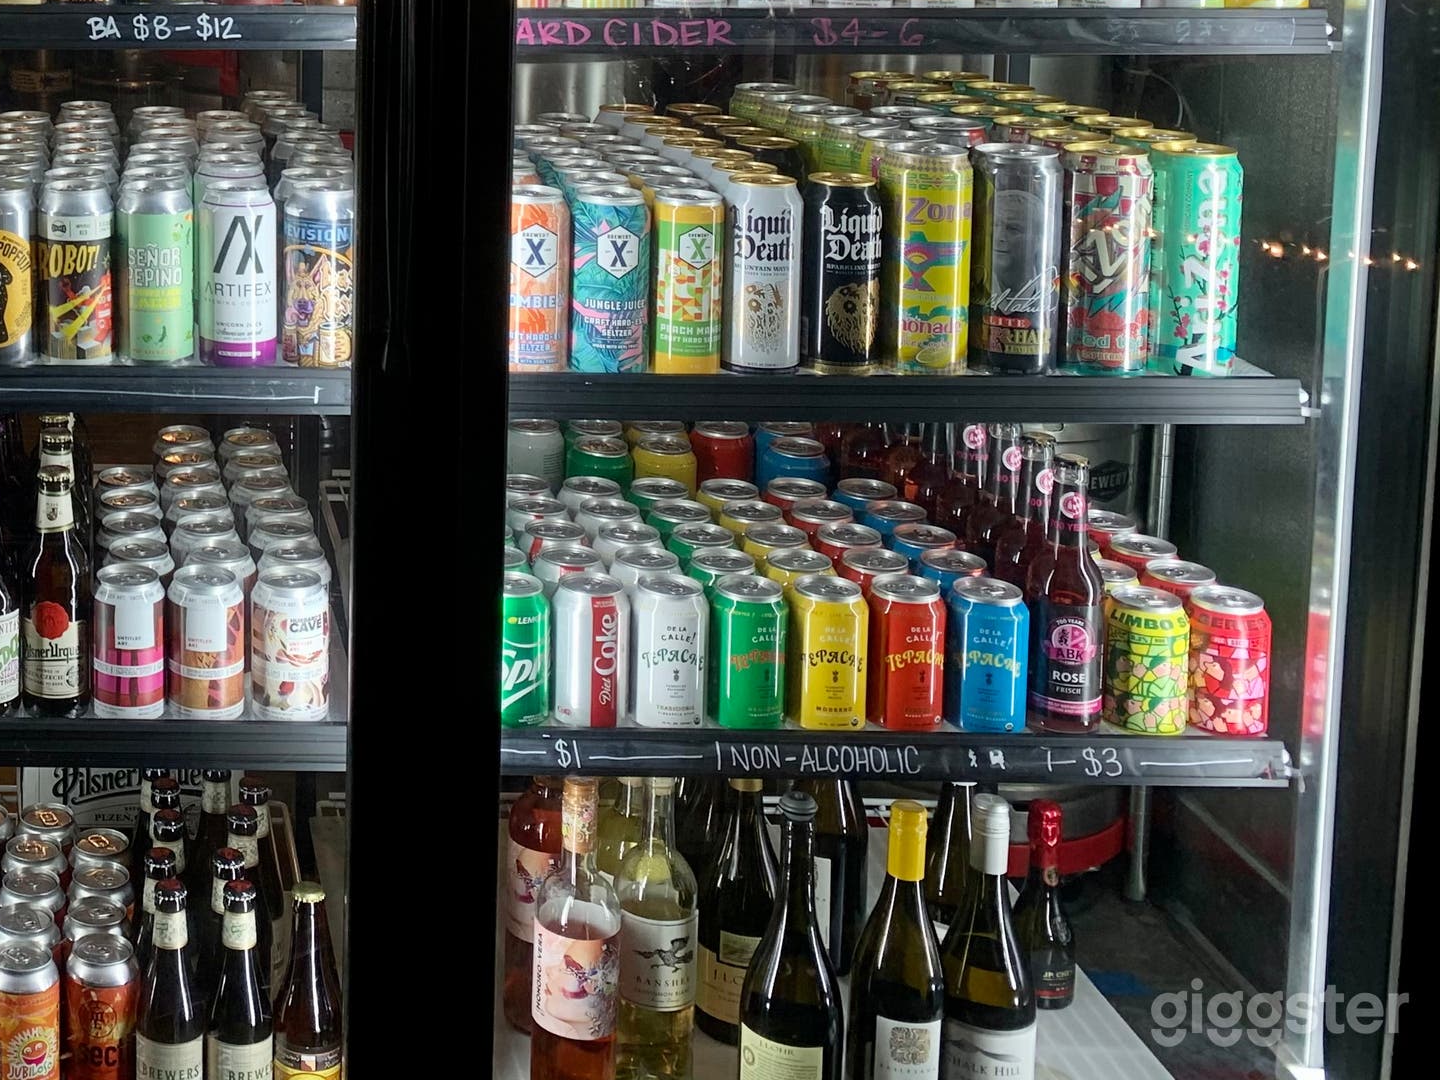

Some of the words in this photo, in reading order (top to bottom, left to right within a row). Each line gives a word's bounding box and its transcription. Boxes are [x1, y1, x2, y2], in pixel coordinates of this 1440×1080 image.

[87, 17, 121, 42] BA
[132, 14, 242, 42] $8-$12
[516, 16, 591, 47] ARD
[603, 17, 735, 47] CIDER
[732, 204, 795, 236] Liquid
[822, 204, 884, 235] Liquid
[128, 243, 181, 266] SEÑOR
[610, 240, 630, 267] X
[733, 234, 796, 262] Death
[824, 234, 883, 261] Death
[40, 243, 101, 280] ROBOT!
[127, 266, 183, 287] PEPINO
[204, 281, 272, 298] ARTIFEX
[584, 298, 621, 311] JUNGLE
[622, 298, 647, 311] JUICE
[289, 619, 323, 632] CAVE
[1110, 608, 1171, 629] LIMBO
[593, 613, 618, 676] Coke
[661, 631, 698, 646] CALLE!
[641, 648, 705, 672] TEPACHE
[1055, 647, 1084, 660] ABK
[1052, 670, 1087, 683] ROSE
[598, 676, 613, 706] Diet
[554, 738, 583, 769] $1
[730, 742, 921, 774] NON-ALCOHOLIC
[1081, 747, 1124, 778] $3
[994, 1062, 1021, 1078] HILL
